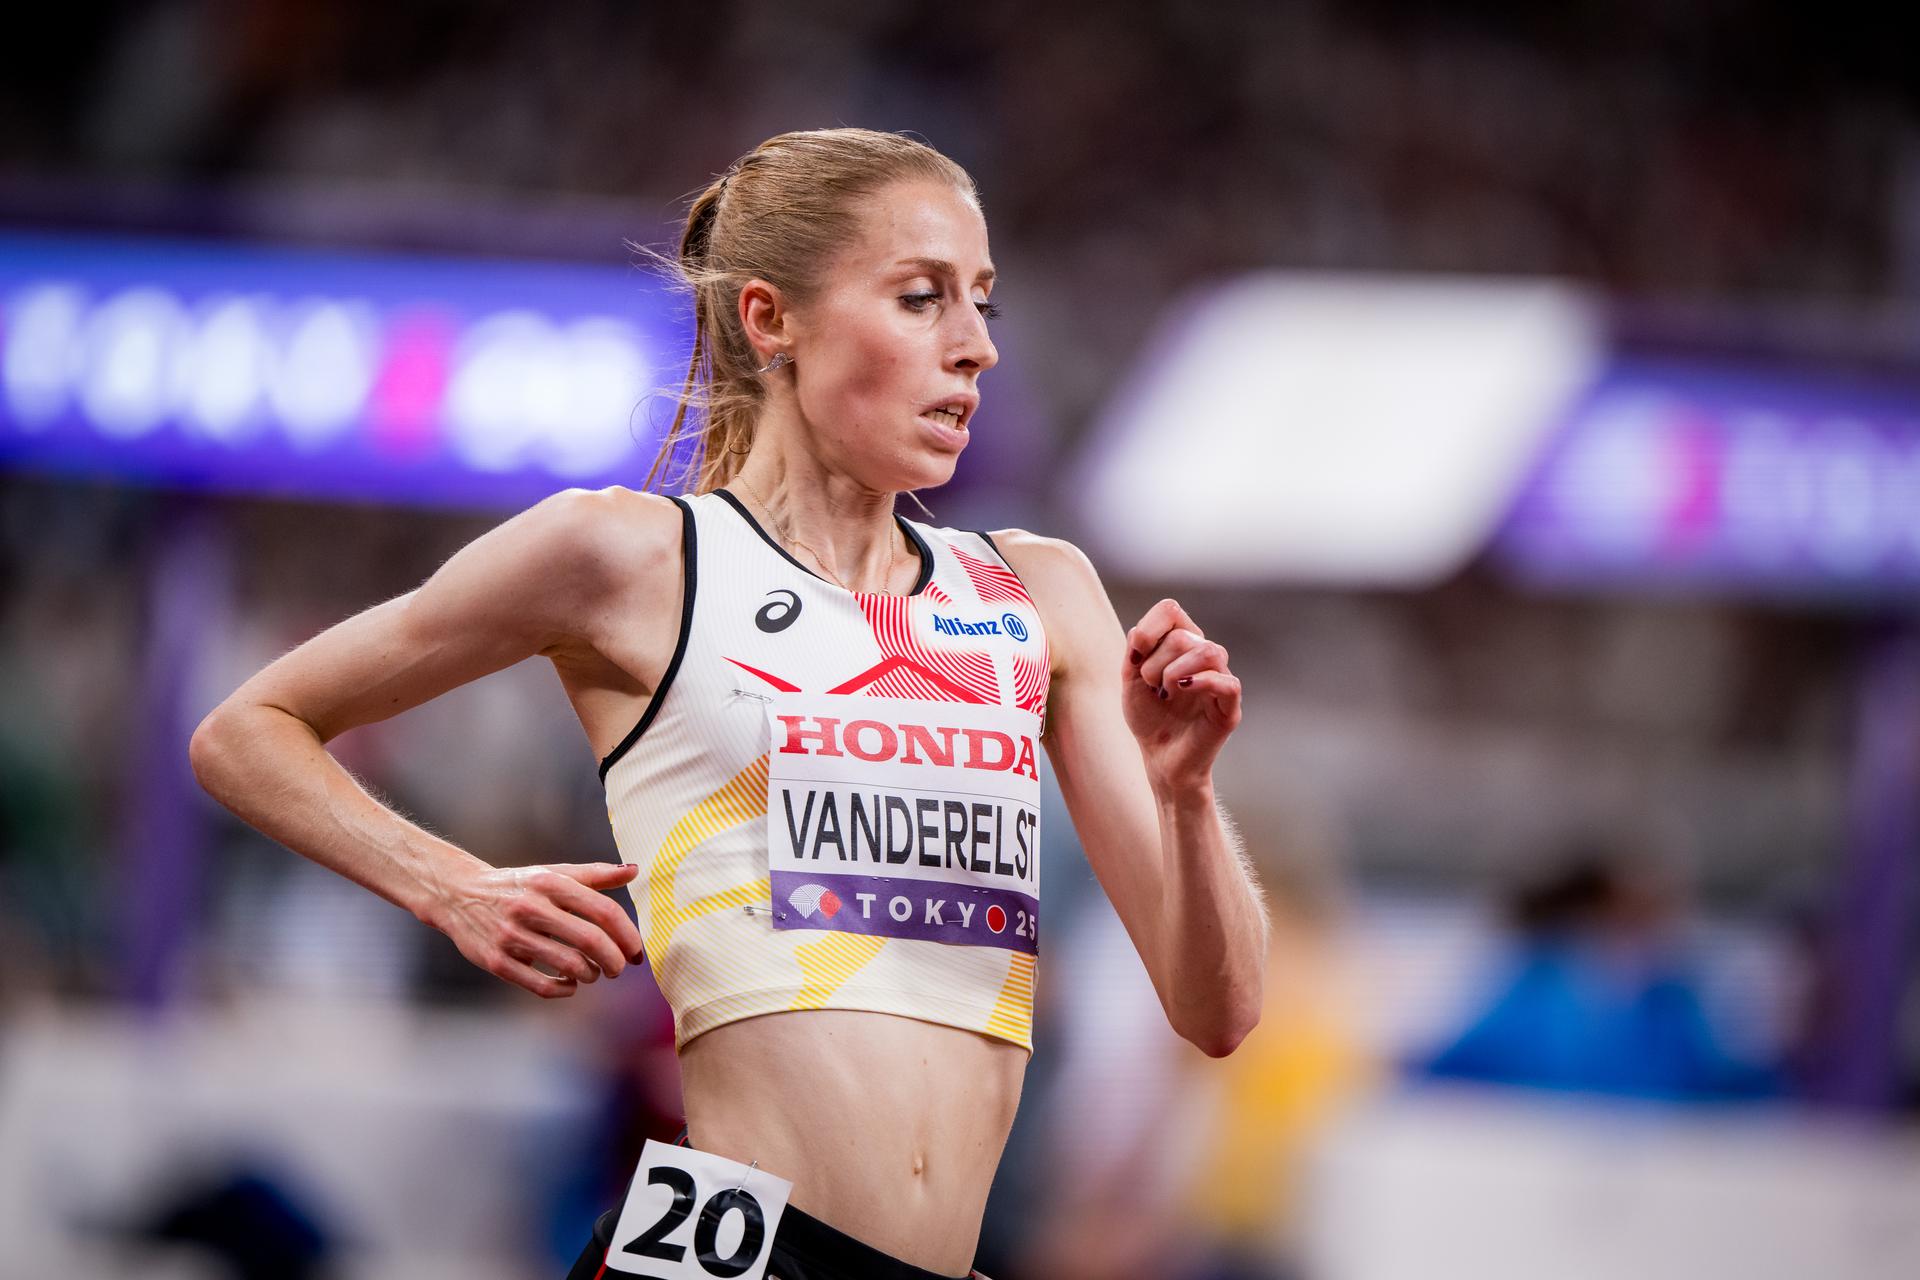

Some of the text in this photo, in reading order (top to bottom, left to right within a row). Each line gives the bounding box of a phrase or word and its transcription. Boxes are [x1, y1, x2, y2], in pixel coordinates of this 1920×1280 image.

[932, 613, 1003, 636] Allianz
[776, 715, 1039, 783] HONDA
[782, 789, 1037, 882] VANDERELST
[856, 893, 1036, 942] TOKYO 25
[622, 1166, 765, 1279] 20
